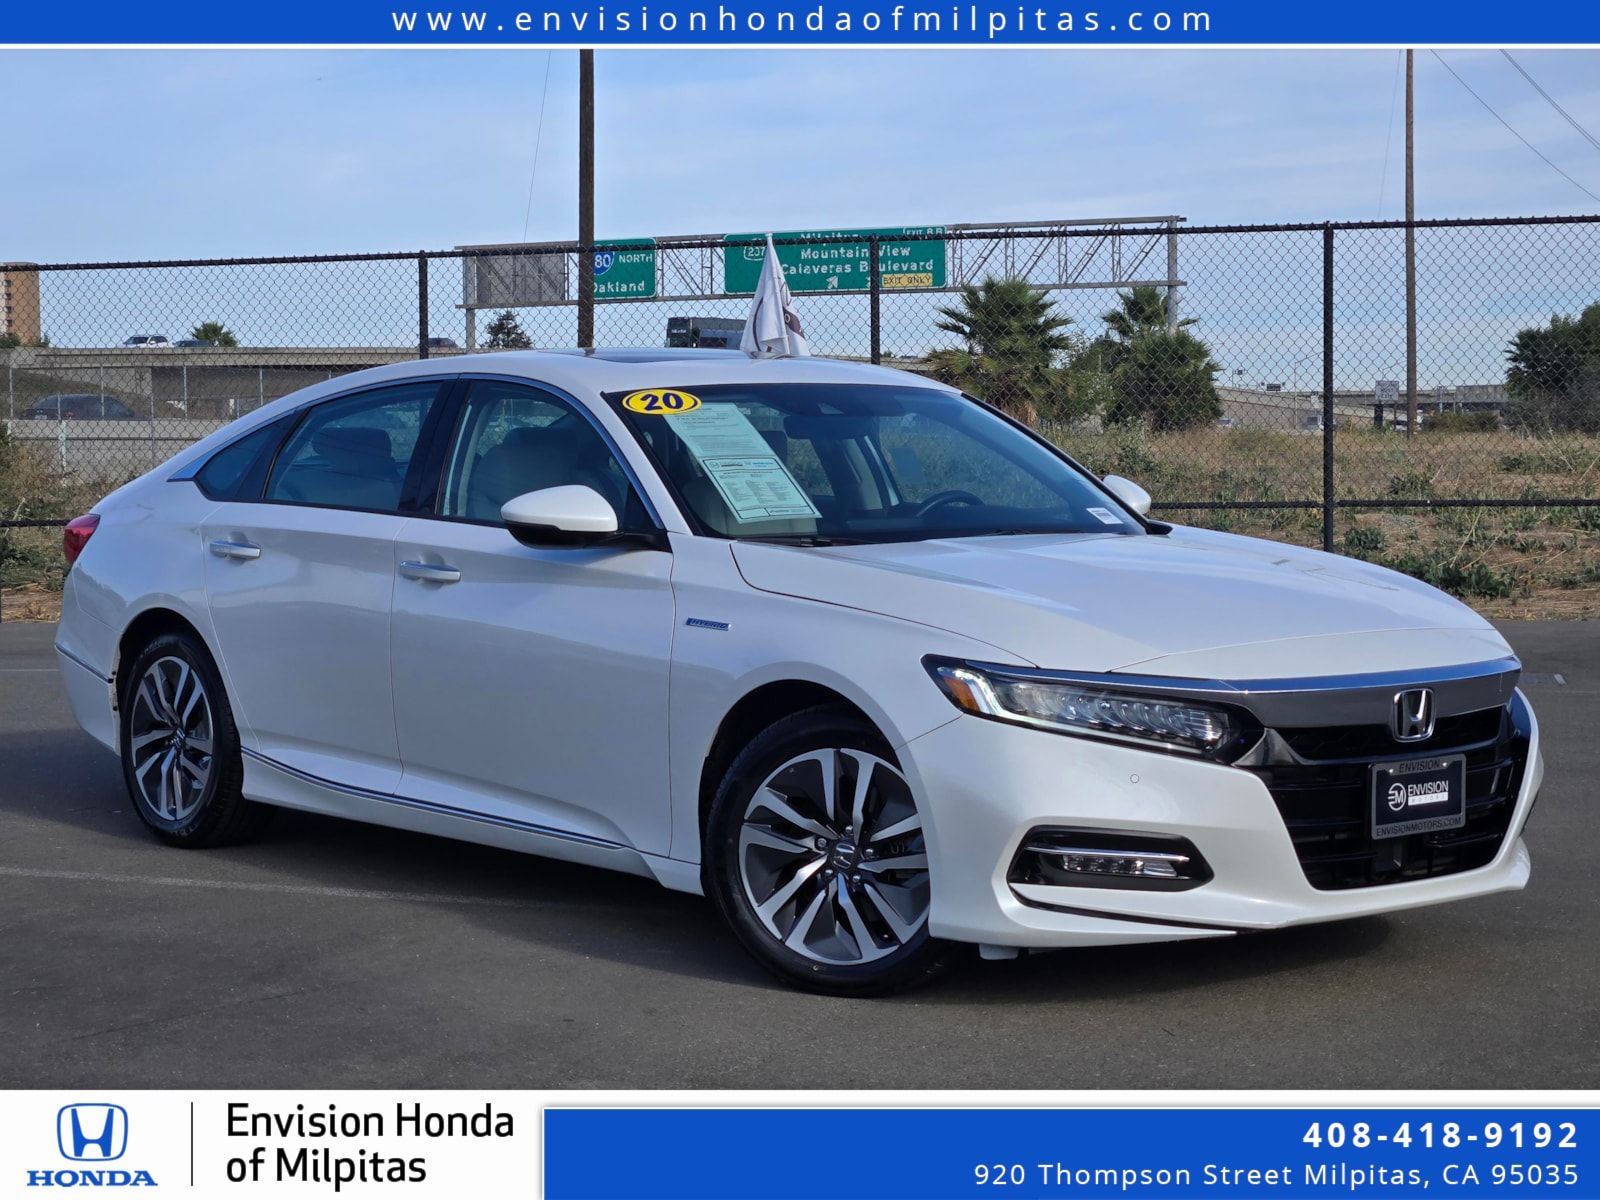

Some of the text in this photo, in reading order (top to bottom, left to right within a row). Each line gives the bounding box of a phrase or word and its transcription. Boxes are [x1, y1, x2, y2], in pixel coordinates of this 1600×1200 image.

[801, 245, 911, 260] Mountain View
[594, 253, 653, 268] 80 NORTH
[781, 259, 934, 275] Calaveras Bulevard
[883, 273, 932, 285] EXIT ONLY
[640, 392, 684, 411] 20
[1399, 759, 1440, 773] ENVISION
[1407, 780, 1449, 796] ENVISION
